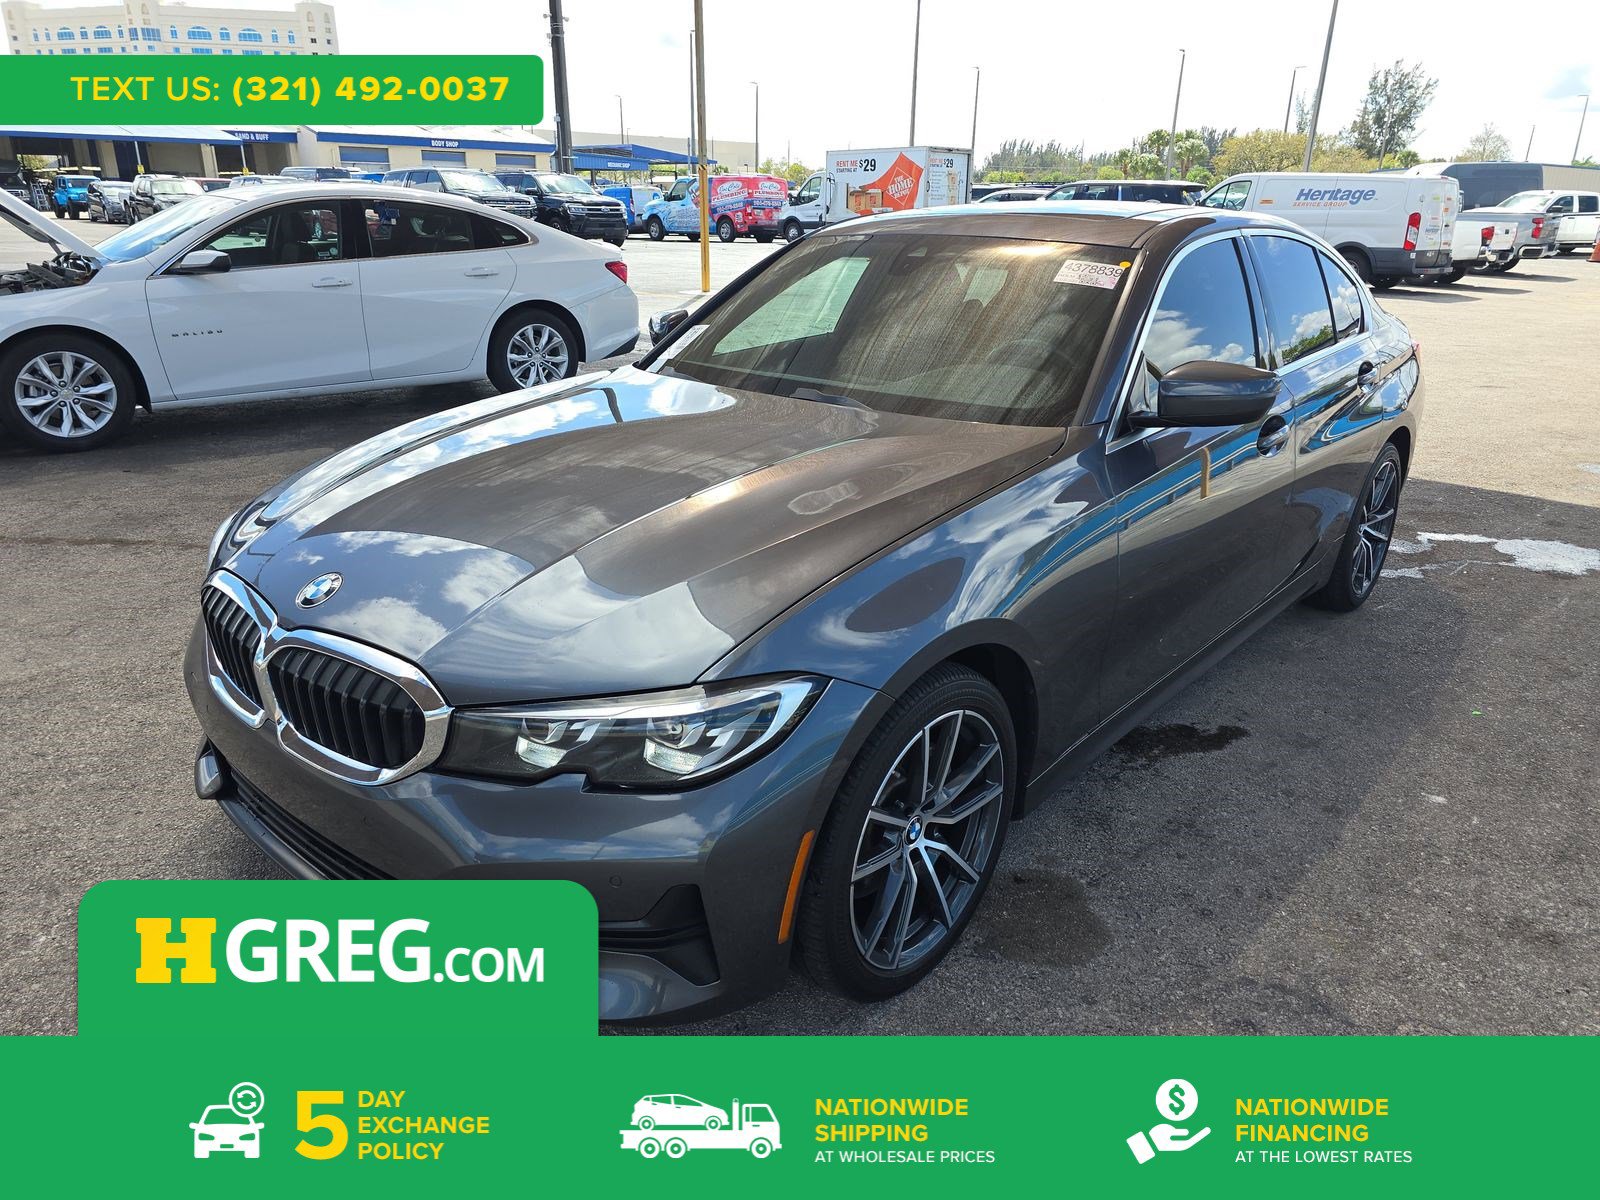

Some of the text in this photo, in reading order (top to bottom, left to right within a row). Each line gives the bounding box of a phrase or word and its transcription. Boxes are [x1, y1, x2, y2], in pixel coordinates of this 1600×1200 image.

[836, 160, 852, 168] RENT
[859, 158, 876, 172] $29
[944, 158, 954, 169] $29
[888, 178, 914, 195] HOME
[712, 189, 747, 202] PLUMBING
[1295, 188, 1376, 205] Heritage
[1065, 262, 1124, 278] 4378839
[171, 329, 223, 337] MALIBU
